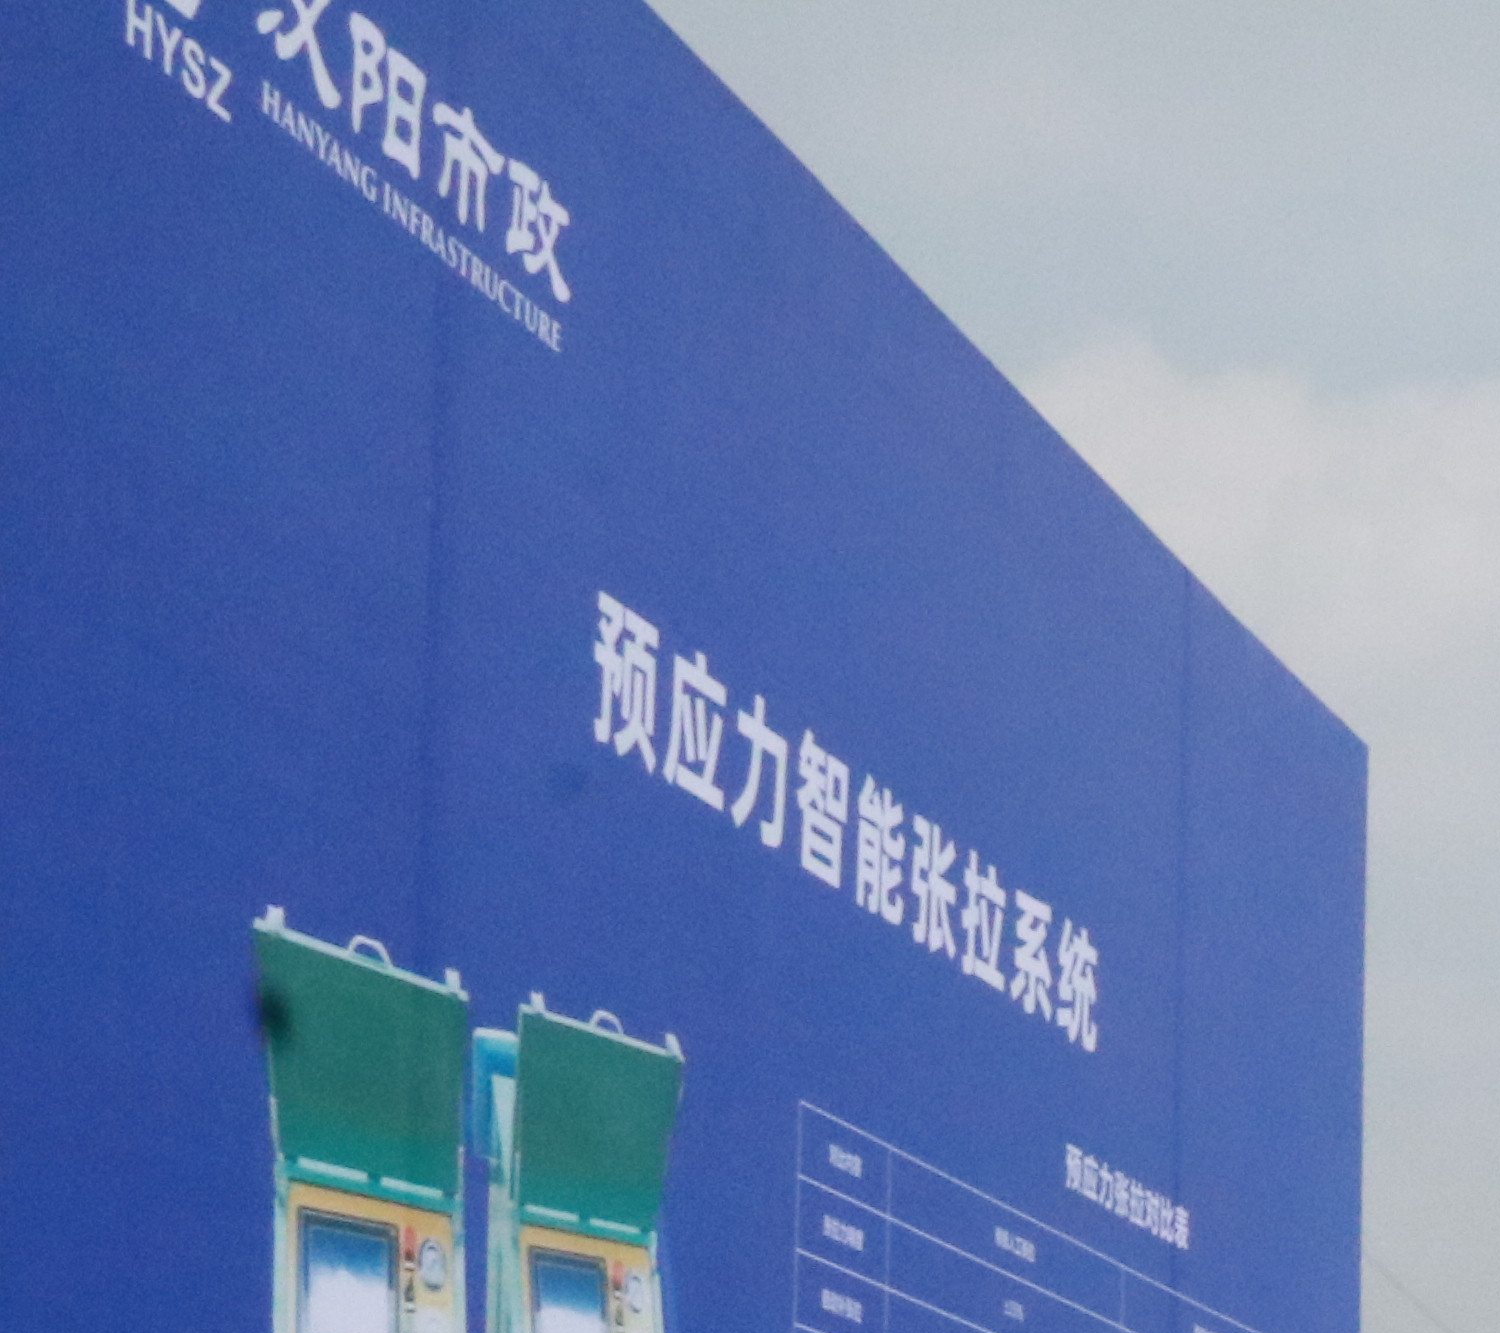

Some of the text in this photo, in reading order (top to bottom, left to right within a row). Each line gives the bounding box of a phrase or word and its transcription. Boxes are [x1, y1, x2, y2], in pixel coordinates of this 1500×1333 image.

[125, 0, 233, 122] HYSZ
[261, 82, 563, 353] HANYANG INFRASTRUCTURE
[594, 591, 1099, 1054] 预应力智能张拉系统
